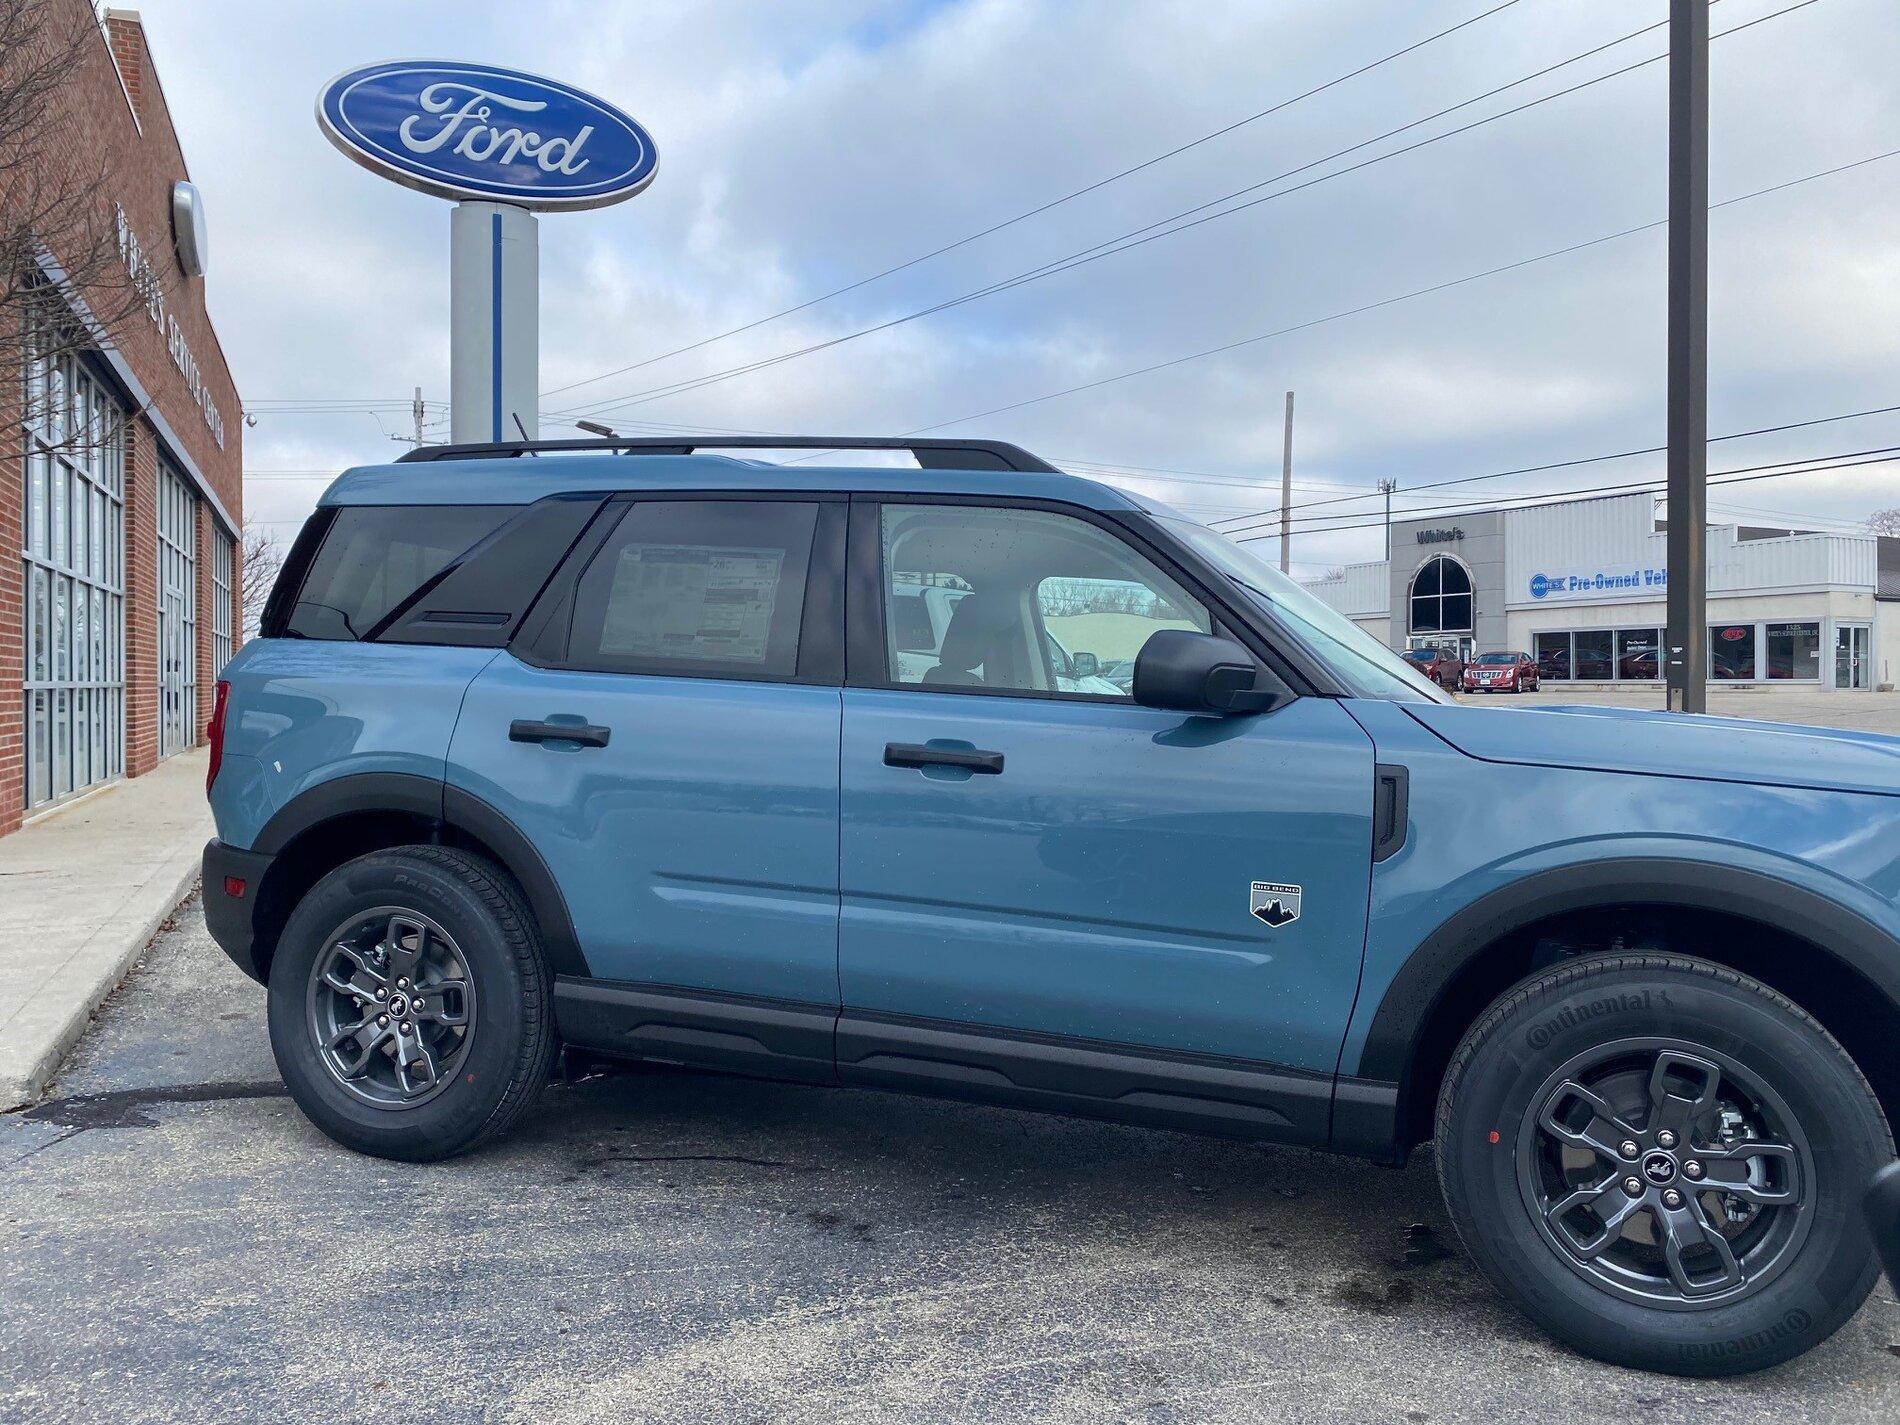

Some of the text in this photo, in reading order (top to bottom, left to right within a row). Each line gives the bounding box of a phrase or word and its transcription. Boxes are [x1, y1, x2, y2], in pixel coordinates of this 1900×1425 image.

[400, 82, 595, 175] Ford
[1416, 526, 1465, 544] White's
[1569, 570, 1640, 592] Pre-Owned
[1525, 989, 1651, 1050] Continental
